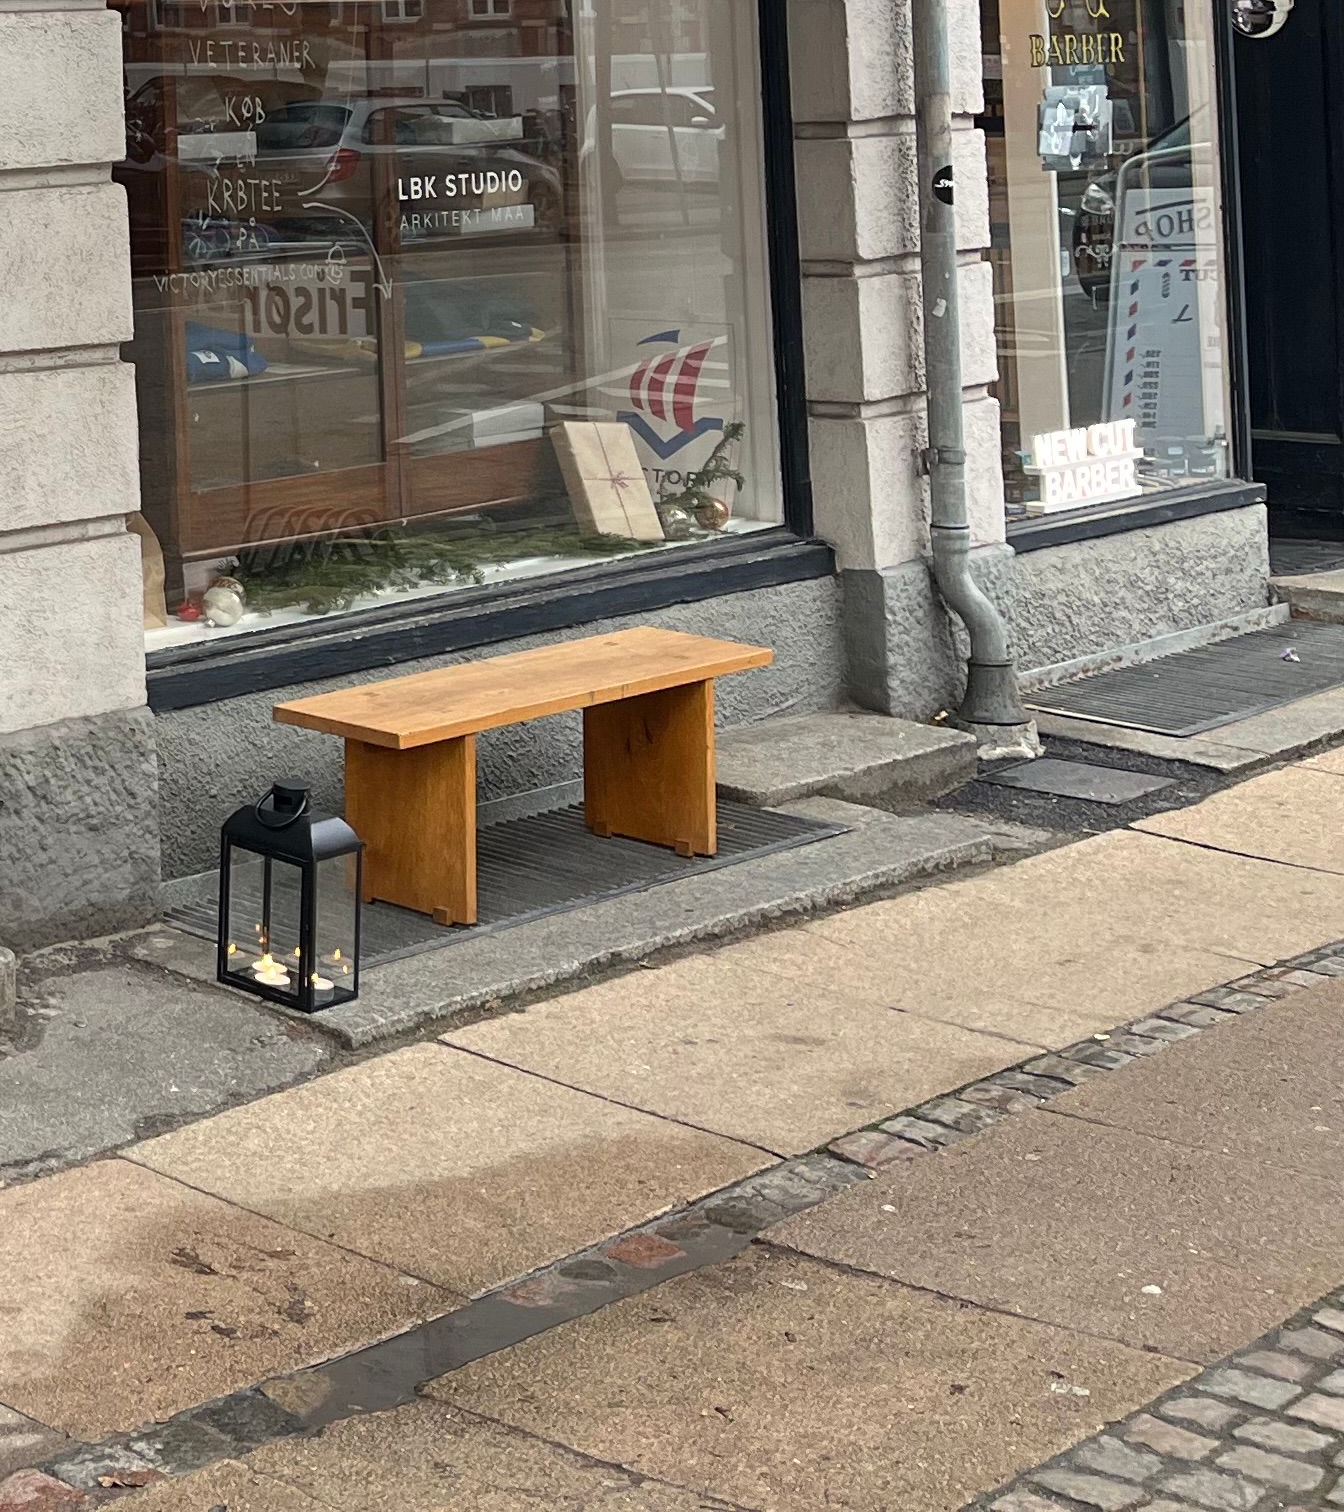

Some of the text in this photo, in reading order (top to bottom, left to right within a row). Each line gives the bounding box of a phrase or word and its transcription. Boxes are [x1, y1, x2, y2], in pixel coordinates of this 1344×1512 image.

[188, 39, 316, 70] VETERANER
[1029, 32, 1126, 68] BARBER
[224, 94, 266, 127] KØB
[397, 169, 523, 201] LBK STUDIO
[235, 216, 260, 250] PÅ
[400, 204, 525, 230] ARKITEKT MAA
[1045, 459, 1136, 504] BARBER
